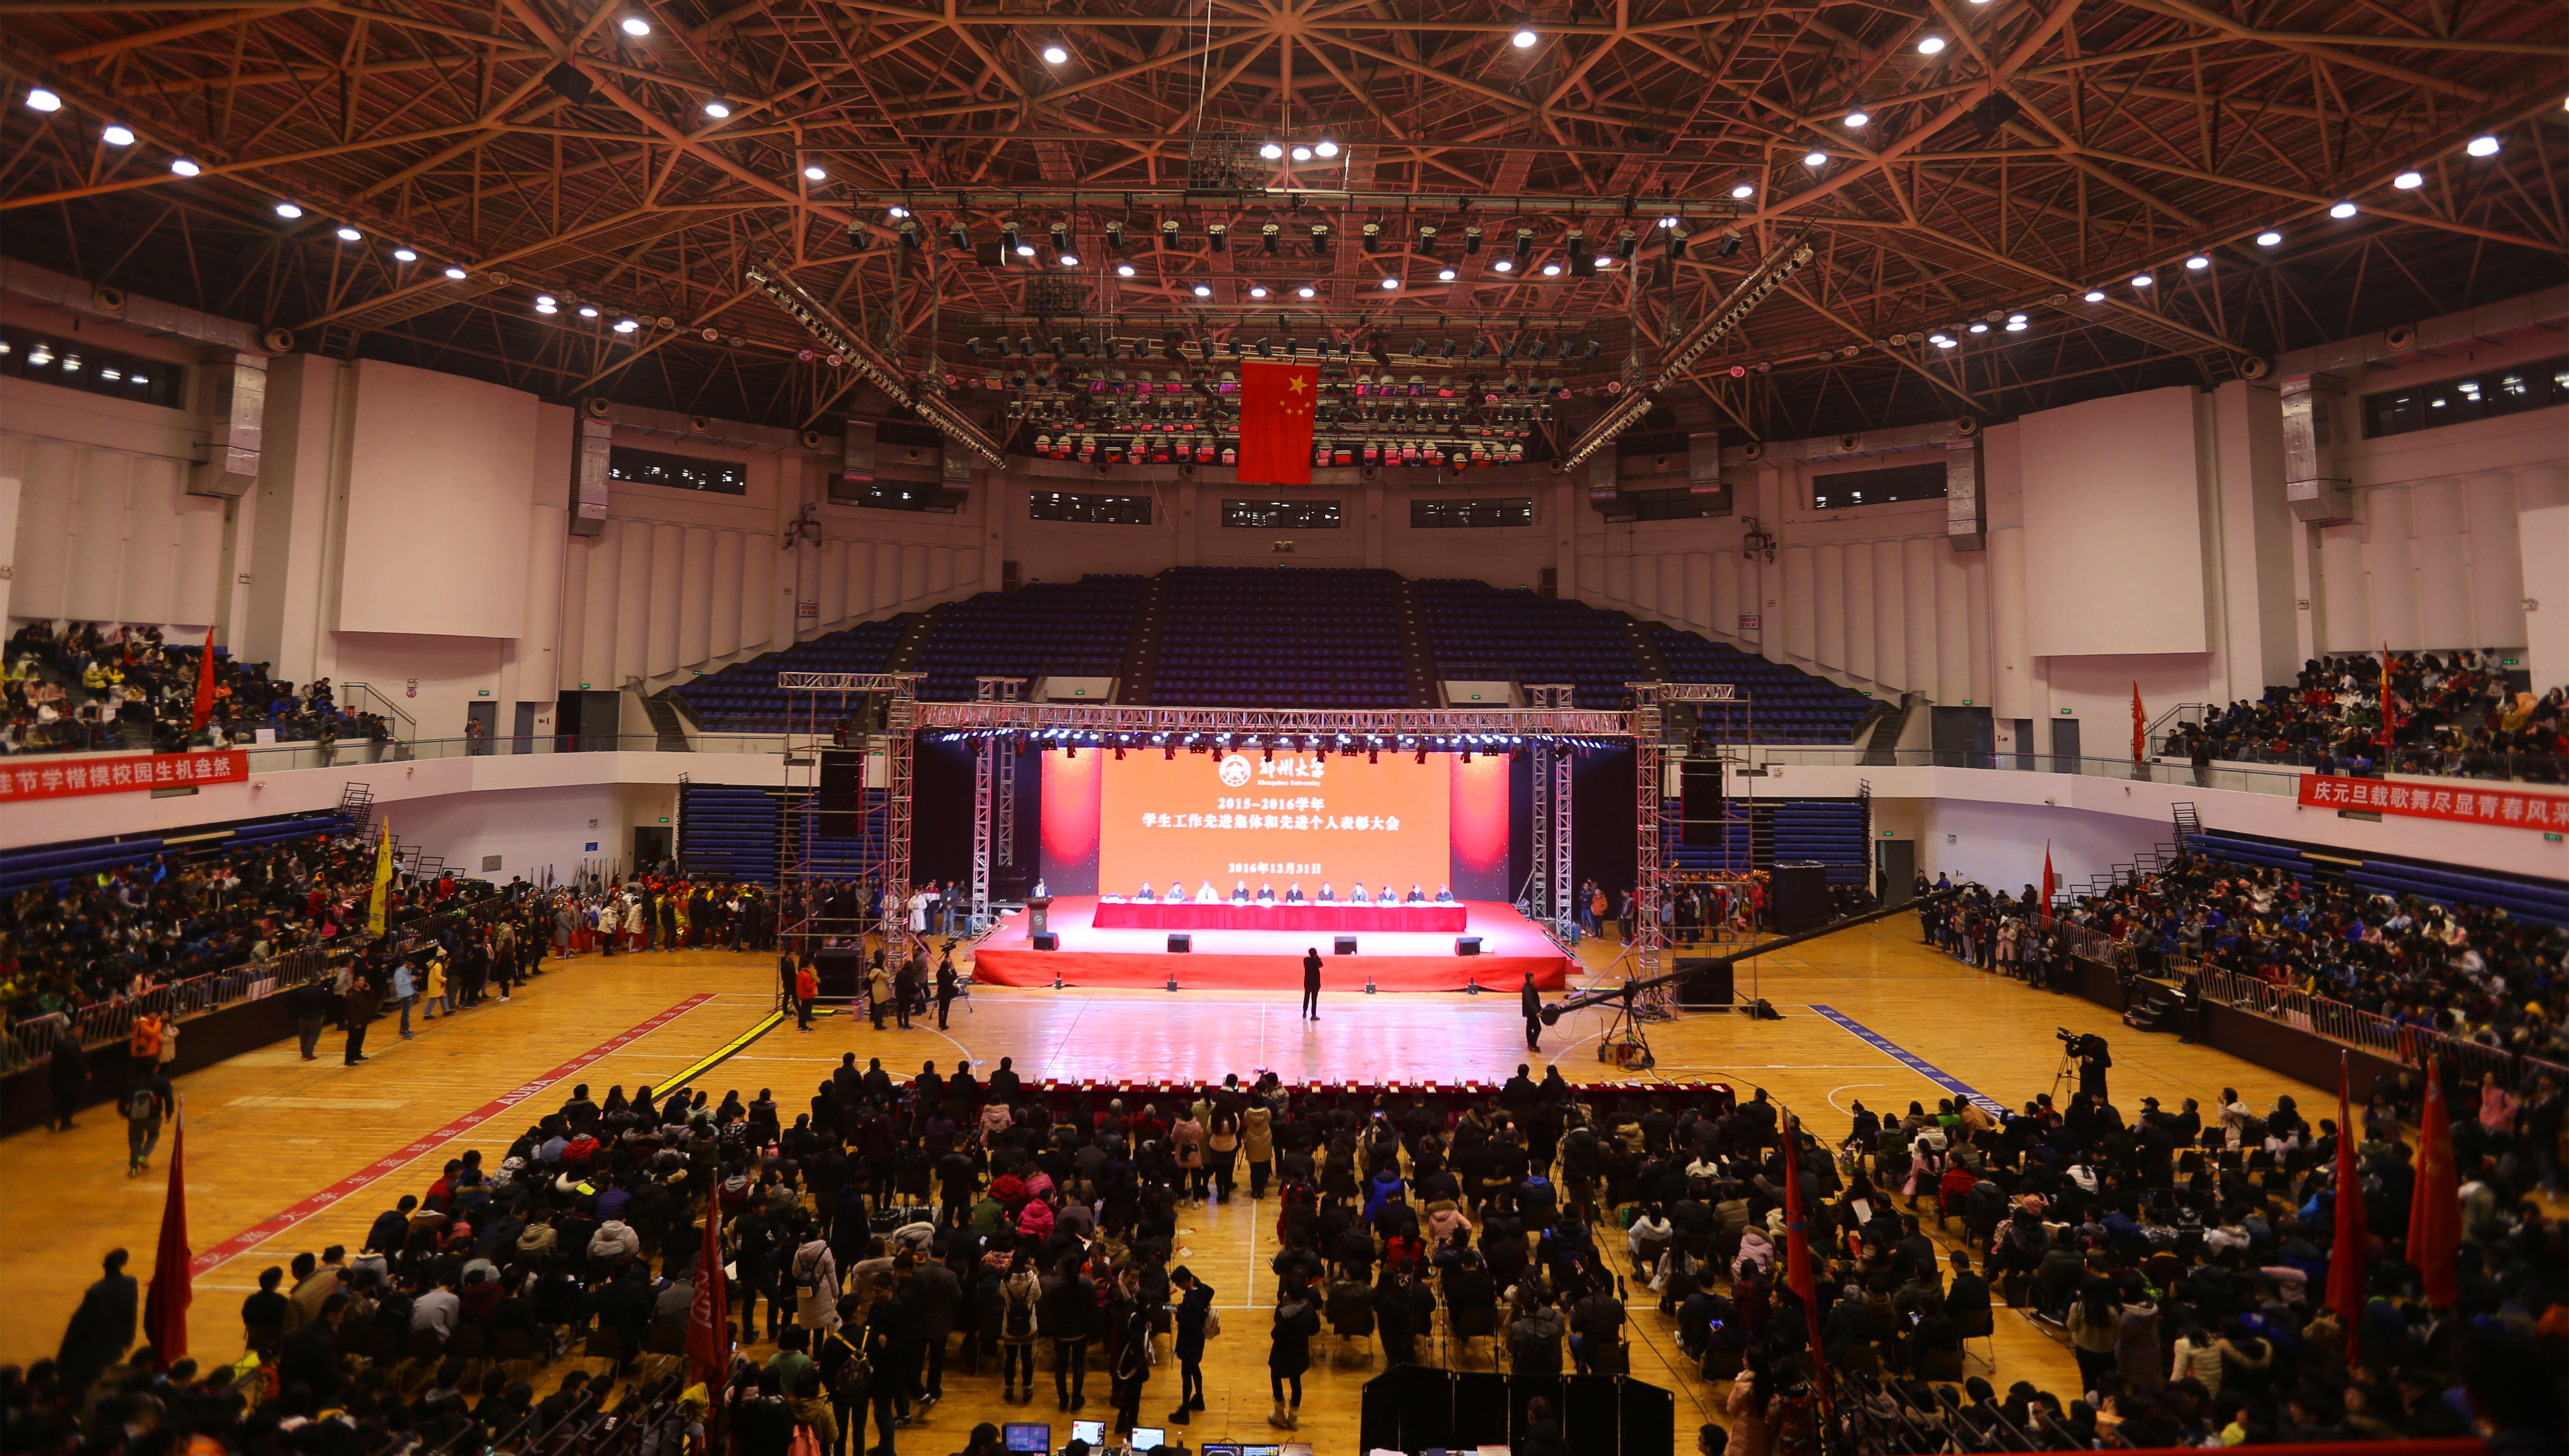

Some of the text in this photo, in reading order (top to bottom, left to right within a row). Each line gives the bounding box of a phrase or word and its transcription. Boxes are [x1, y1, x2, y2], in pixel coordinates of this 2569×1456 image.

[1217, 797, 1325, 812] 2015-2016学年
[1142, 813, 1400, 831] 学生工作先进集体和先进个人表彰大会
[1228, 862, 1322, 874] 2016年12月31日
[495, 1079, 557, 1106] AUBA
